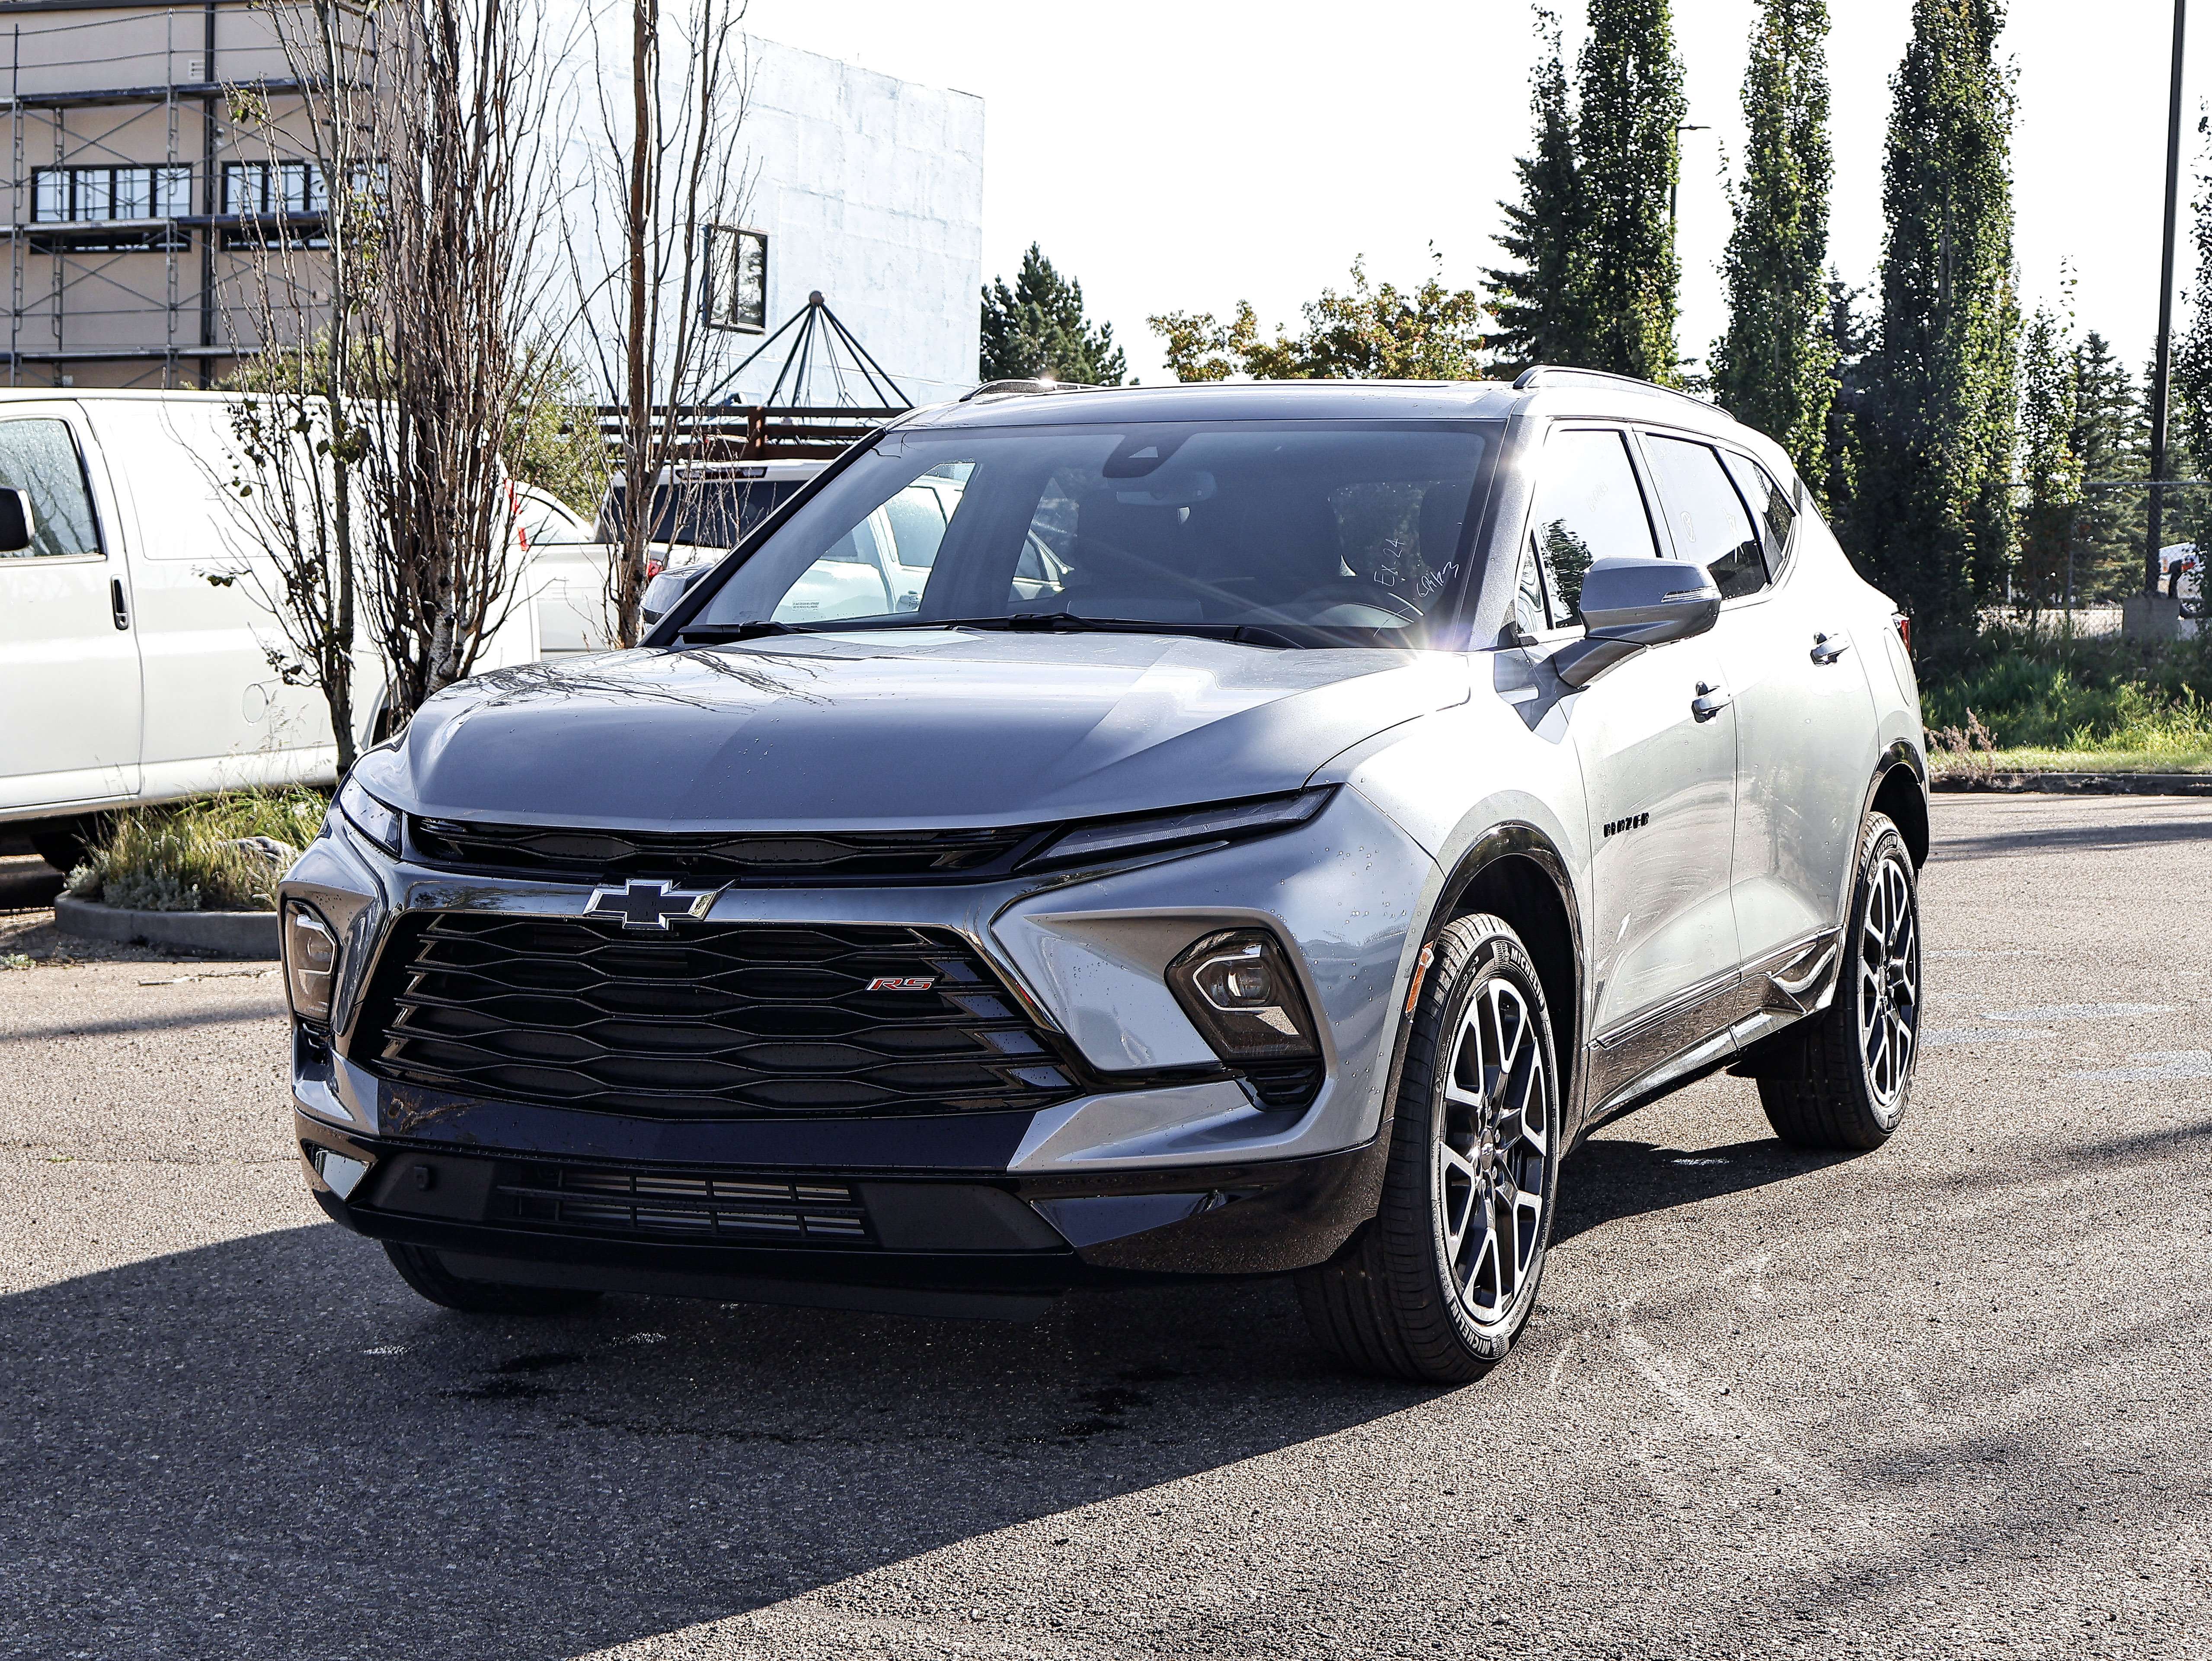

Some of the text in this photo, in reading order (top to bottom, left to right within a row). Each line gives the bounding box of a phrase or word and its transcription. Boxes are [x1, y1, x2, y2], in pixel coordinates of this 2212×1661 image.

[1603, 812, 1649, 838] BLAZER
[865, 978, 935, 991] RS
[1510, 947, 1545, 1007] MICHELIN
[1450, 1301, 1491, 1355] MICHELIN
